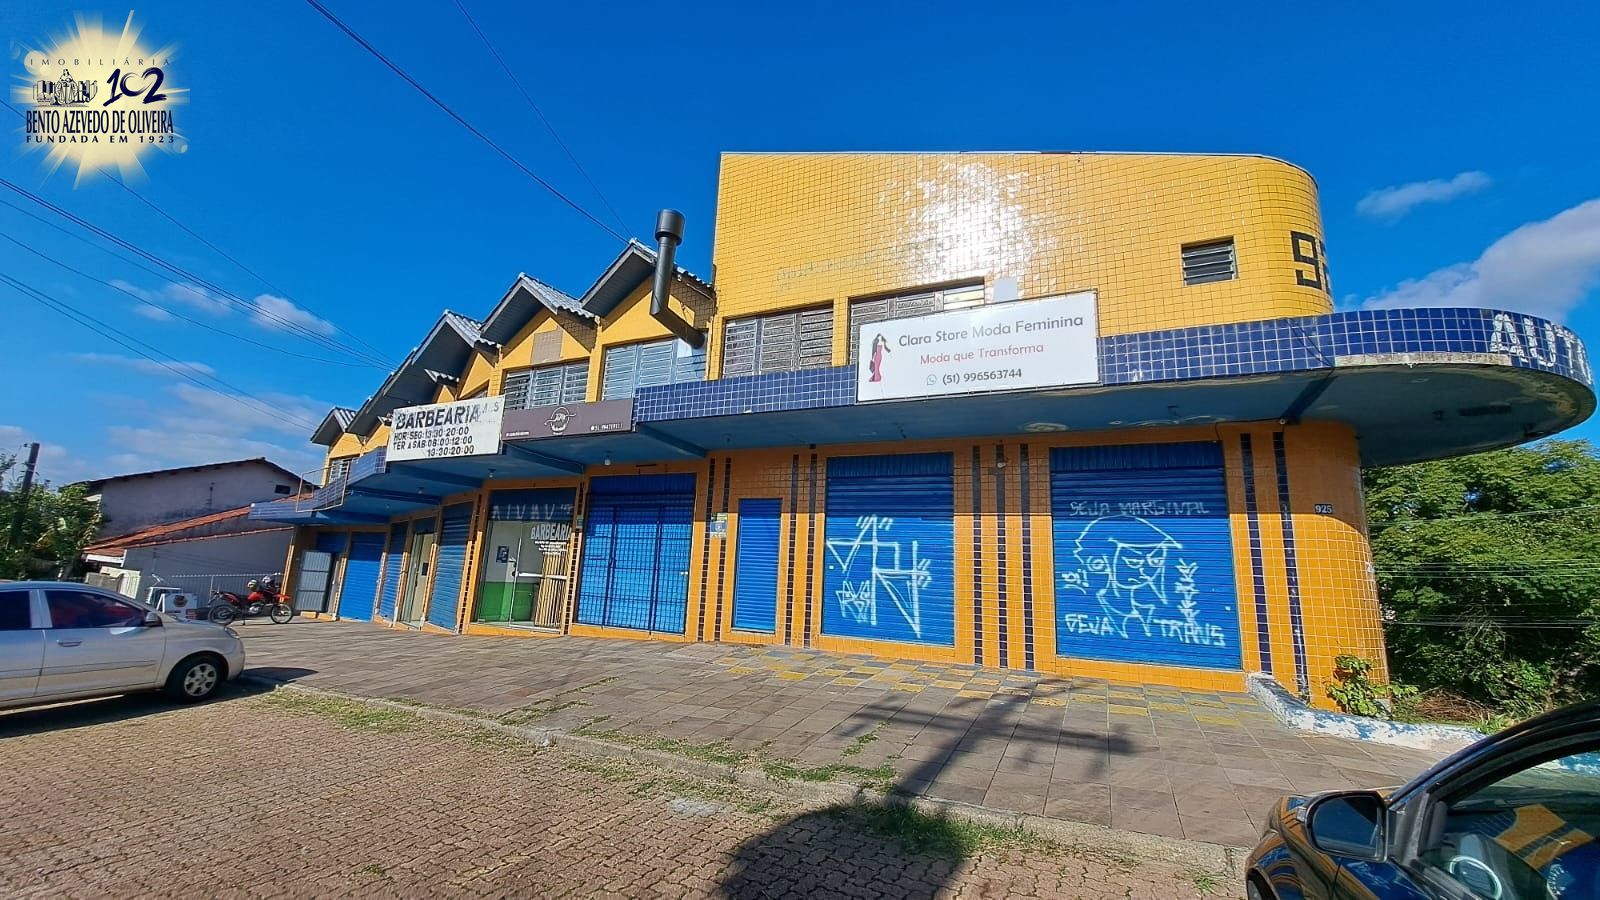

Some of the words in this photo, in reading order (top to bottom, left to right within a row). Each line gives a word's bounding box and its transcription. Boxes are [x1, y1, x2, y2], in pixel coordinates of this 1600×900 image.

[899, 334, 932, 348] Clara
[935, 329, 968, 343] Store
[972, 323, 1011, 338] Moda
[1015, 315, 1084, 334] Feminina
[920, 353, 951, 365] Moda
[953, 350, 975, 363] que
[978, 344, 1044, 359] Transforma
[942, 372, 961, 385] (51)
[963, 368, 1022, 382] 996563744
[396, 404, 480, 429] BARBEARIA
[393, 441, 406, 451] TER
[1315, 504, 1332, 514] 925
